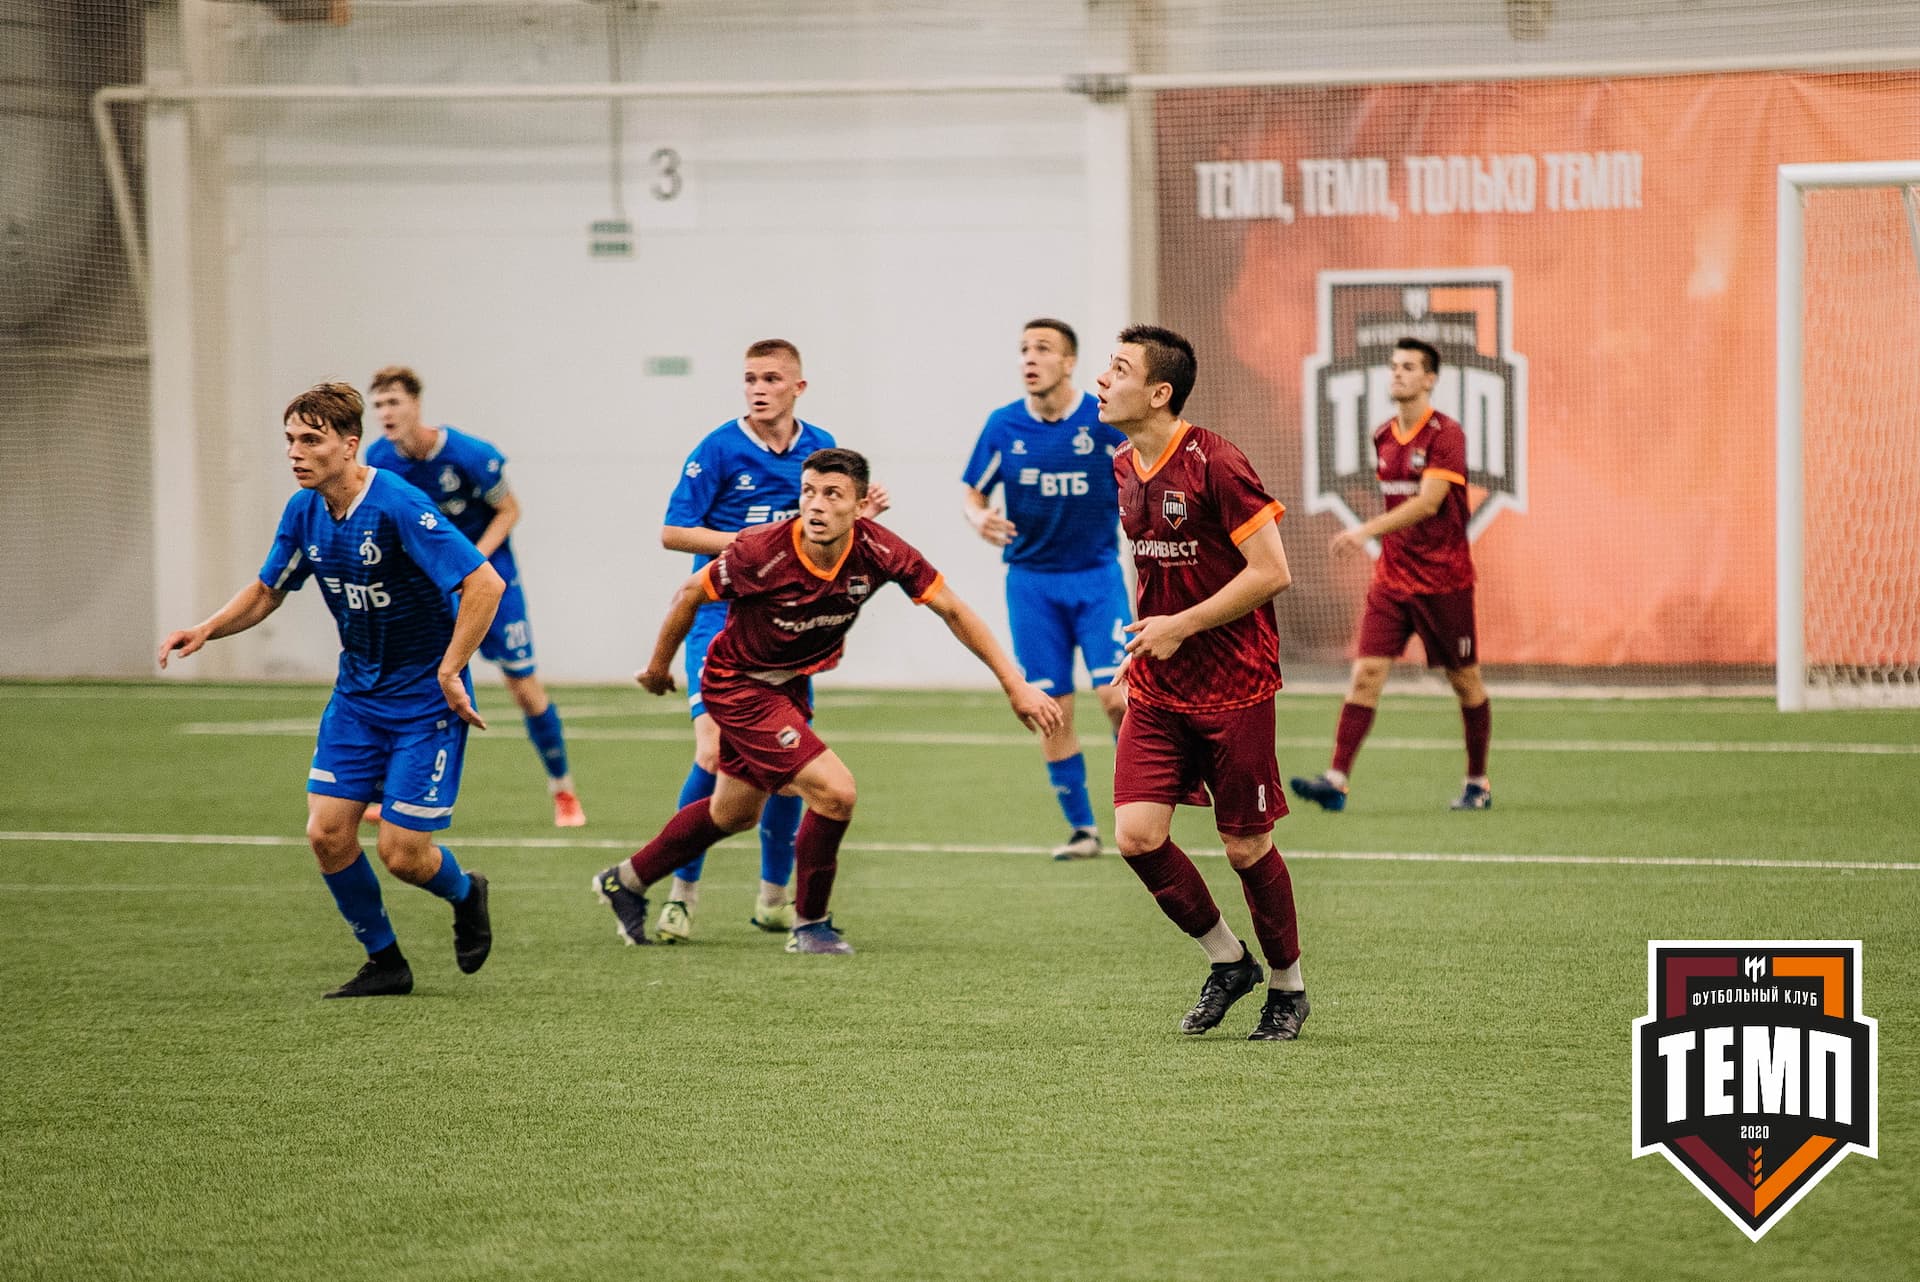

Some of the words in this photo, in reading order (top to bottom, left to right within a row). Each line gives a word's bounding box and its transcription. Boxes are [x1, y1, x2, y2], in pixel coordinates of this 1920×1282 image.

[651, 149, 681, 200] 3
[1195, 160, 1294, 223] ТЕМП,
[1301, 158, 1399, 221] ТЕМП,
[1405, 153, 1536, 213] ТОЛЬКО
[1545, 151, 1643, 211] ТЕМП!
[1041, 472, 1089, 496] ВТБ
[344, 582, 391, 611] ВТБ
[431, 749, 447, 782] 9
[1258, 784, 1267, 812] 8
